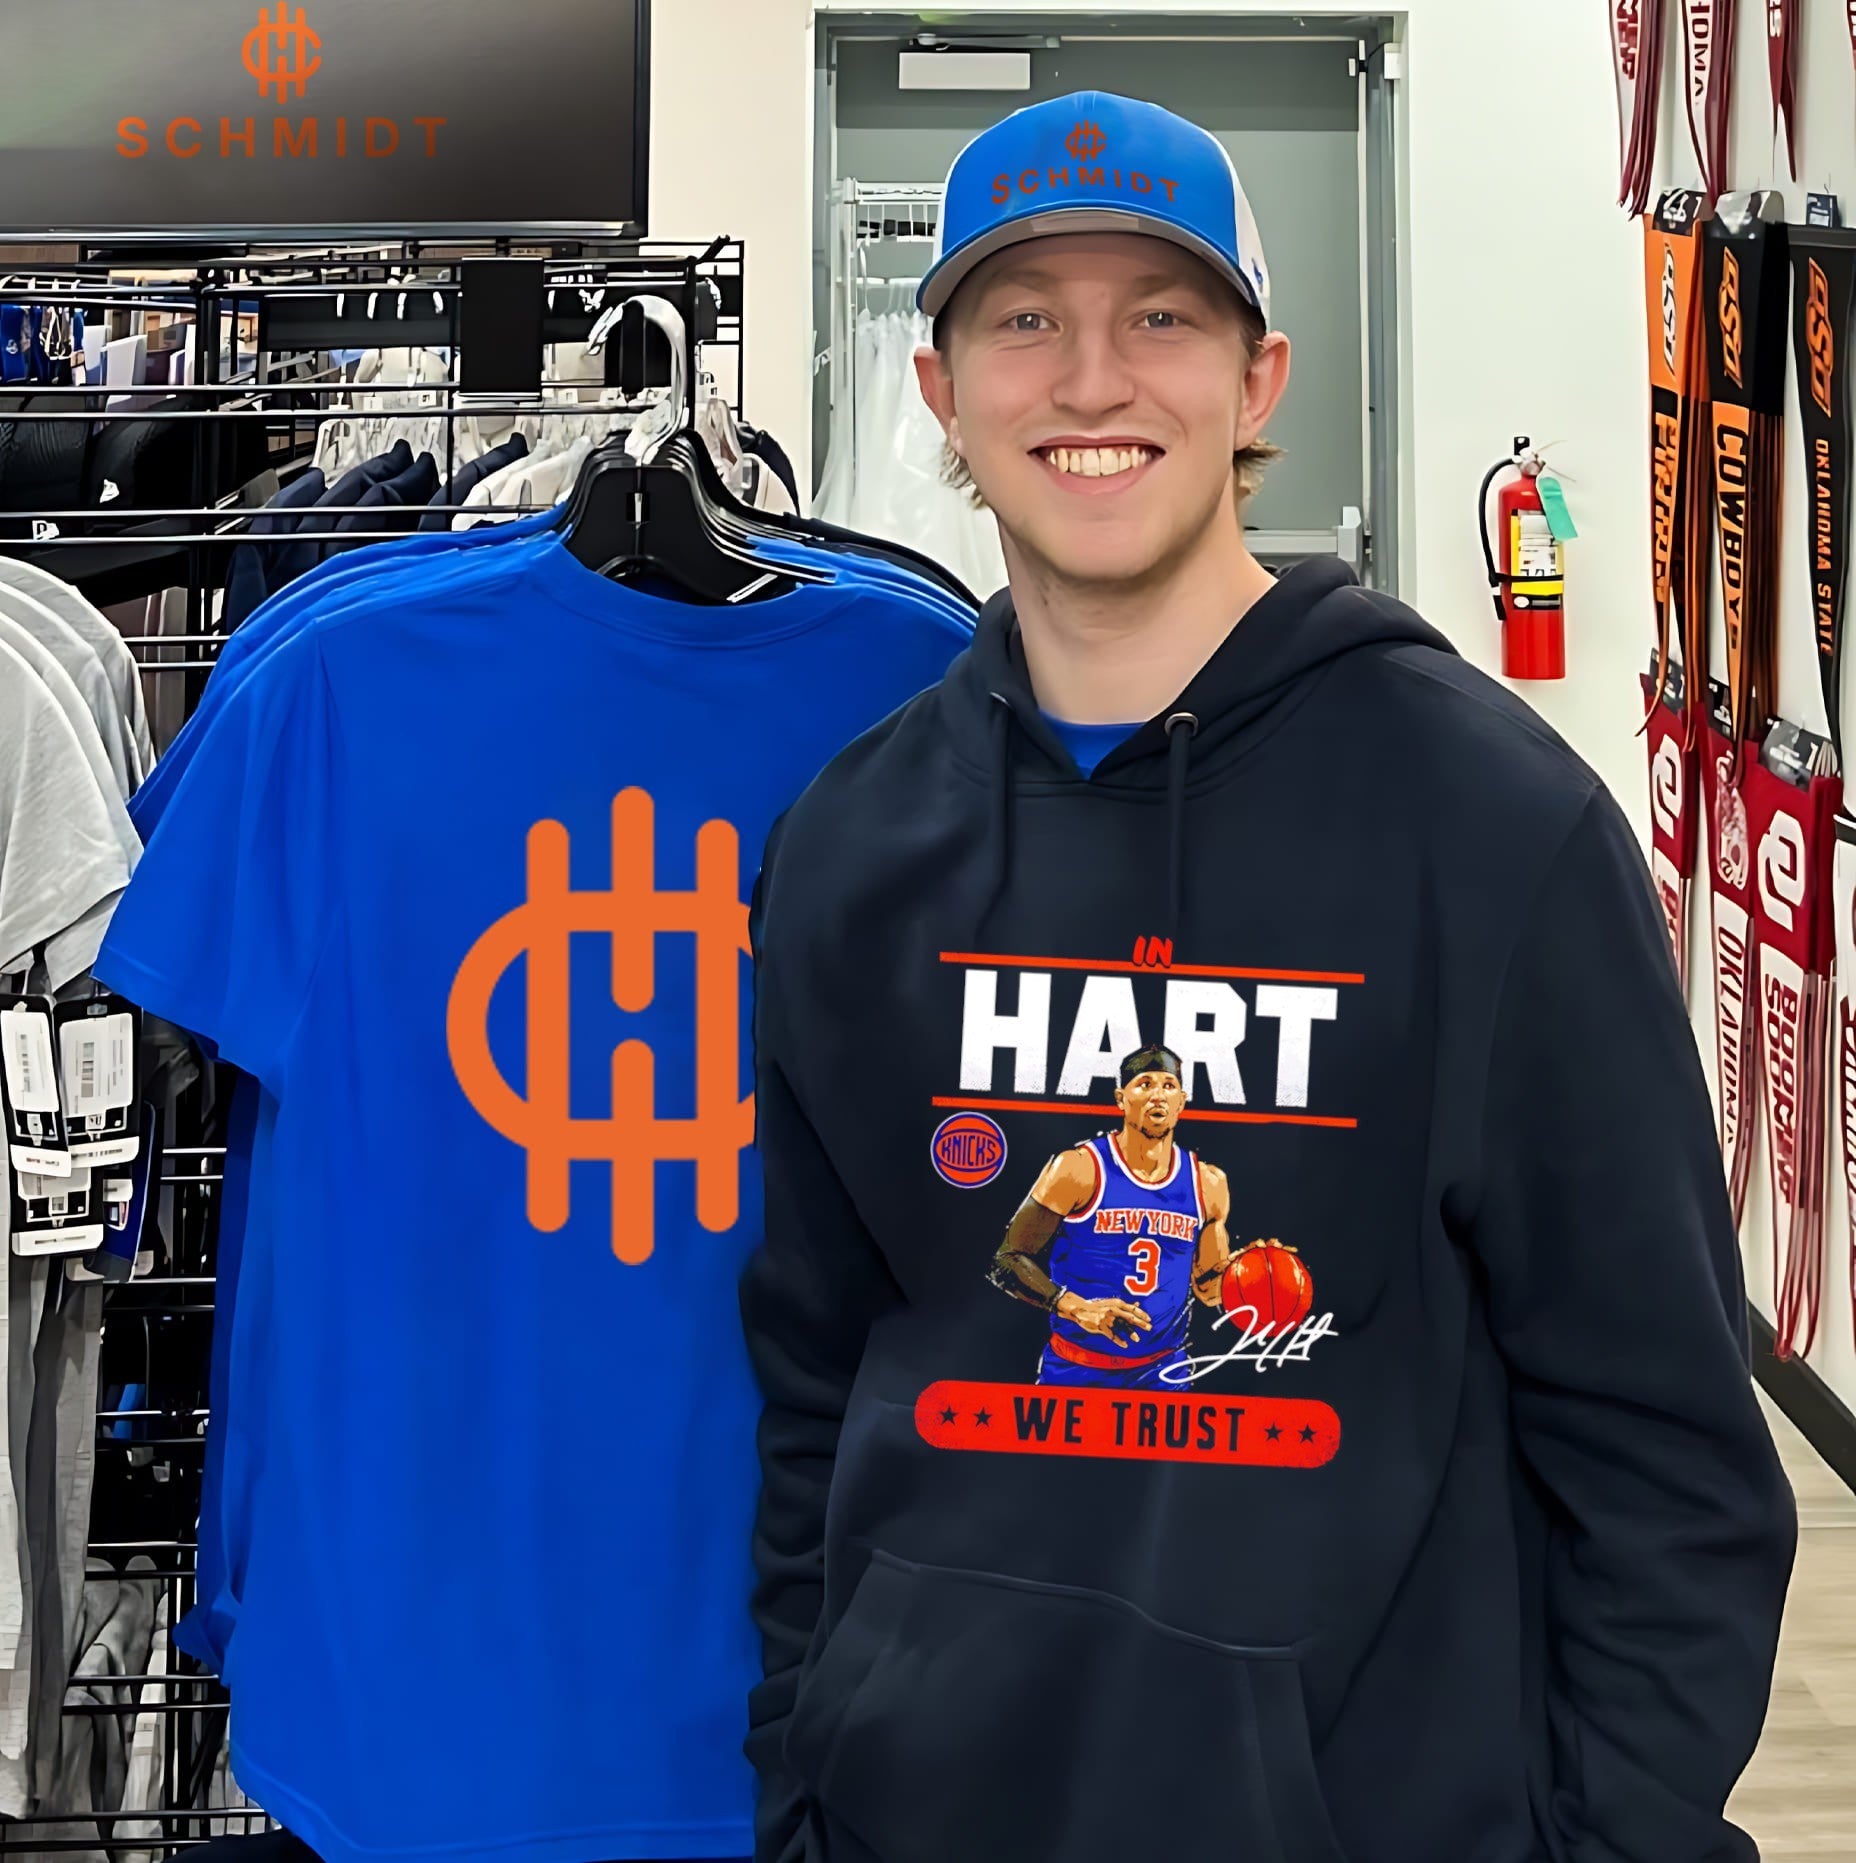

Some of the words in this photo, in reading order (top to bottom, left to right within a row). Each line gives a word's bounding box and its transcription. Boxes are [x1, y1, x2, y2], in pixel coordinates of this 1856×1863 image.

[115, 115, 448, 159] SCHMIDT
[991, 167, 1180, 205] SCHMIDT
[1132, 935, 1175, 968] IN
[959, 969, 1338, 1108] HART
[1718, 926, 1746, 1145] OKLAHOMA
[940, 1131, 998, 1169] KNICKS
[1093, 1208, 1143, 1234] NEW
[1147, 1210, 1198, 1242] YORK
[1123, 1238, 1162, 1297] 3
[1013, 1396, 1084, 1444] WE
[1111, 1401, 1246, 1451] TRUST
